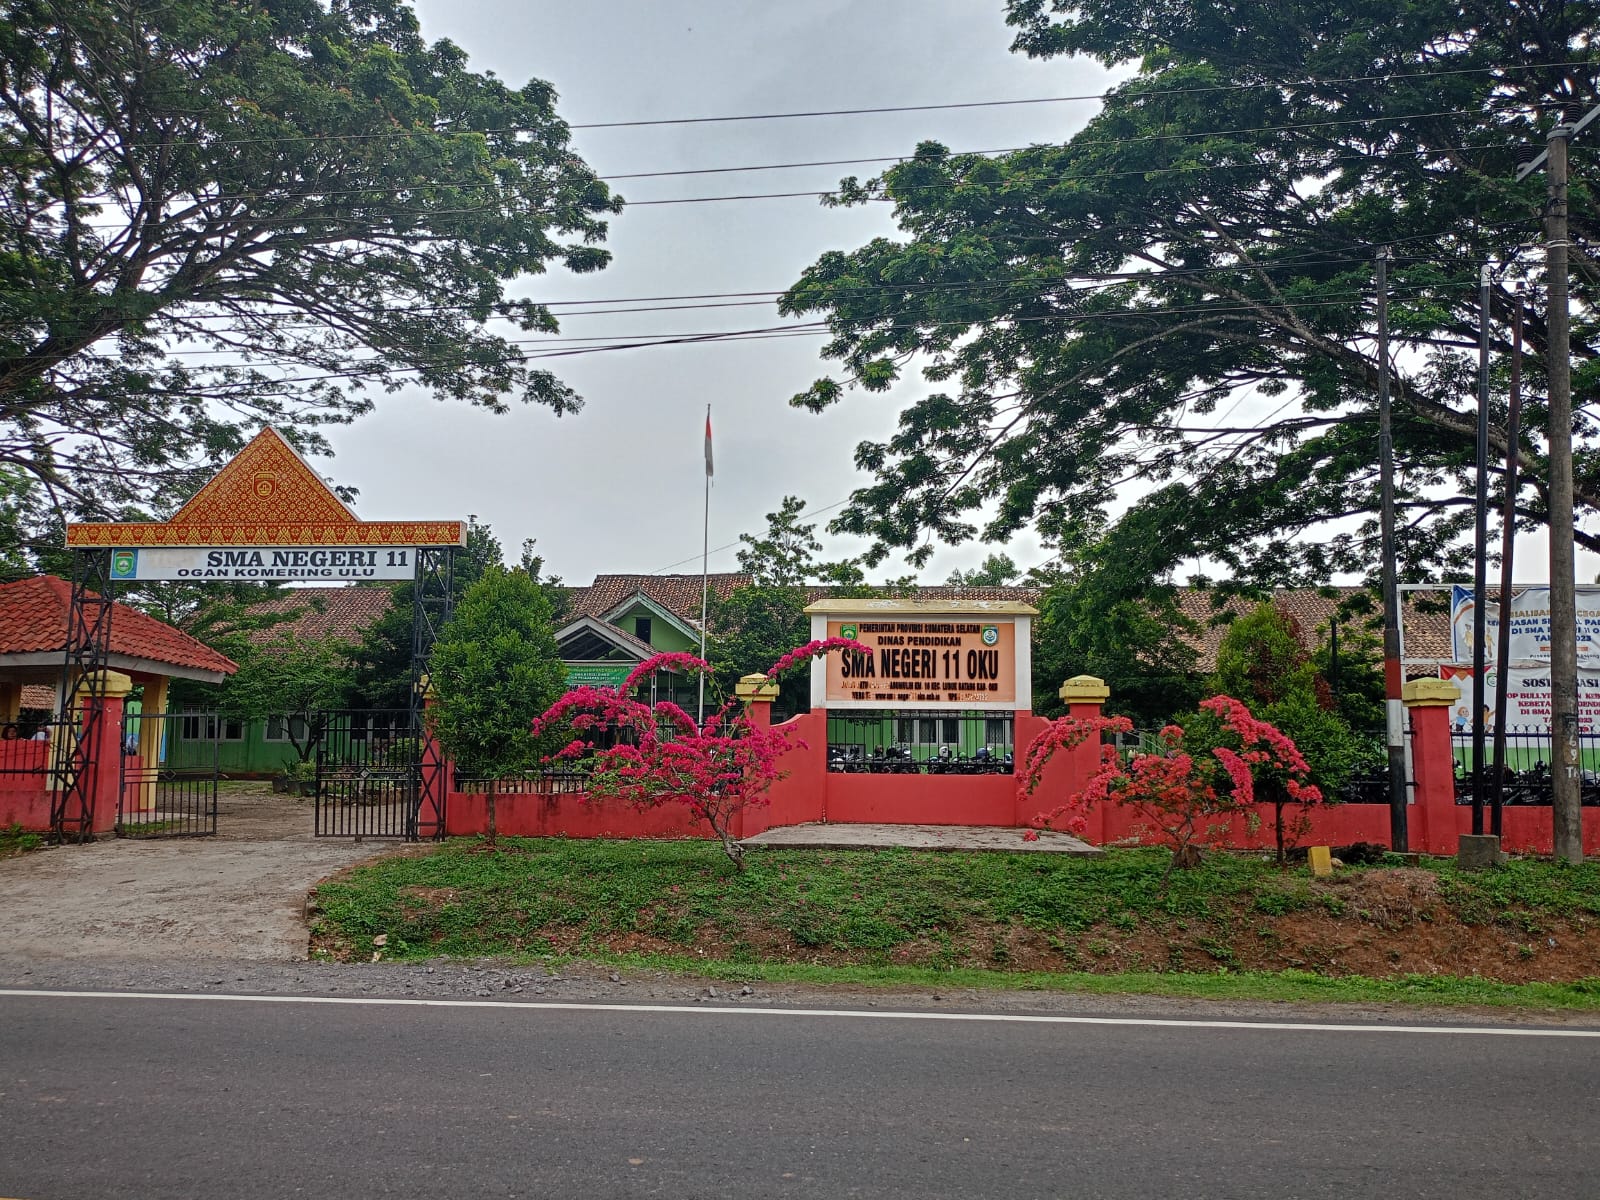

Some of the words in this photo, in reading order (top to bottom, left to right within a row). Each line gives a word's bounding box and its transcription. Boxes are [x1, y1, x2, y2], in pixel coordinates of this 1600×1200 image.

[207, 551, 264, 567] SMA
[271, 551, 377, 567] NEGERI
[386, 551, 408, 567] 11
[859, 624, 895, 632] PEMERINTAH
[897, 624, 923, 633] PROVINSI
[925, 624, 955, 633] SUMATERA
[956, 624, 980, 634] SELATAN
[878, 636, 904, 645] DINAS
[908, 636, 961, 646] PENDIDIKAN
[841, 649, 875, 678] SMA
[881, 649, 936, 678] NEGERI
[943, 650, 959, 679] 11
[967, 650, 998, 679] OKU
